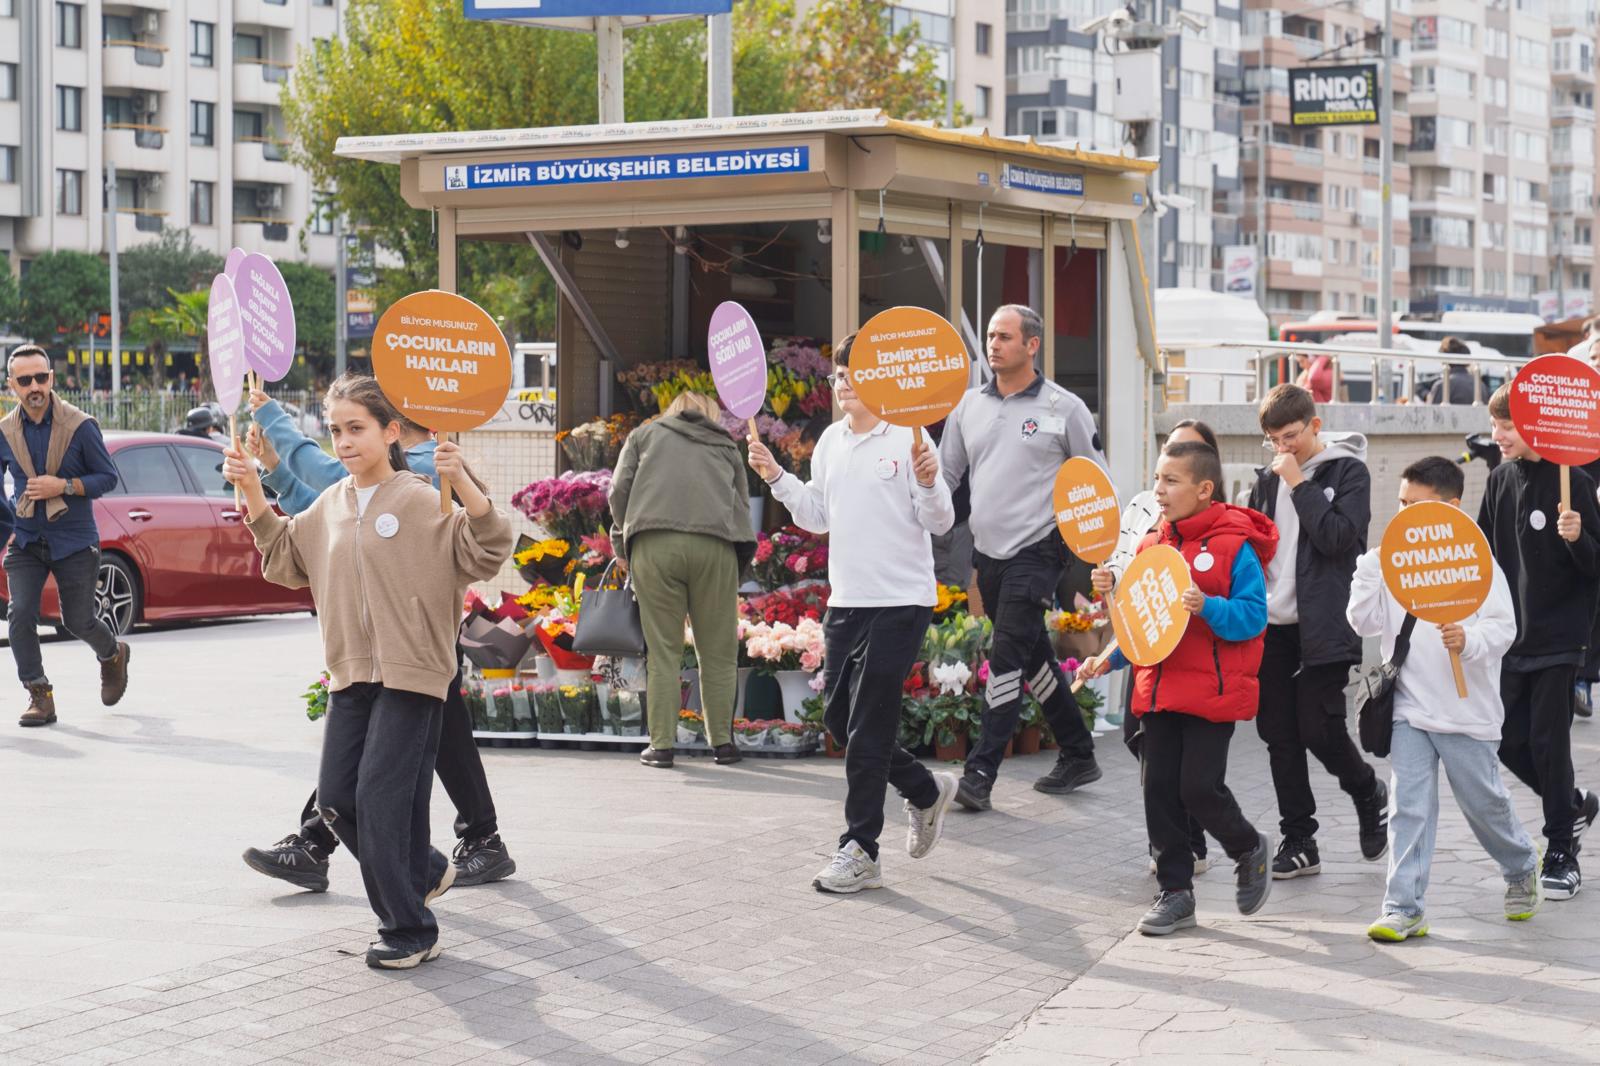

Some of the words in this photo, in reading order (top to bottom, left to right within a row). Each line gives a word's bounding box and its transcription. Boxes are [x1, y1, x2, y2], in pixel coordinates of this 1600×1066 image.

[1294, 72, 1367, 101] RİNDO
[1325, 99, 1374, 112] MOBİLYA
[474, 163, 531, 184] İZMİR
[536, 157, 670, 181] BÜYÜKŞEHİR
[676, 148, 800, 173] BELEDİYESİ
[401, 315, 431, 326] BİLİYOR
[432, 320, 478, 331] MUSUNUZ?
[710, 318, 748, 349] ÇOCUKLARIN
[870, 332, 897, 343] BİLİYOR
[897, 327, 937, 338] MUSUNUZ?
[385, 333, 496, 356] ÇOCUKLARIN
[715, 340, 736, 365] SÖZÜ
[734, 335, 752, 354] VAR
[405, 355, 478, 374] HAKLARI
[854, 364, 906, 385] ÇOCUK
[908, 353, 965, 375] MECLİSİ
[425, 376, 459, 392] VAR
[896, 376, 926, 390] VAR
[1518, 380, 1556, 396] ŞİDDET,
[1558, 385, 1590, 399] İHMAL
[1531, 373, 1590, 388] ÇOCUKLARI
[1528, 393, 1597, 410] İSTİSMARDAN
[1540, 406, 1589, 419] KORUYUN
[1067, 483, 1096, 503] EĞİTİM
[1058, 508, 1074, 524] HER
[1073, 496, 1116, 521] ÇOCUĞUN
[1078, 516, 1104, 534] HAKKI
[1405, 523, 1454, 543] OYUN
[1391, 543, 1478, 568] OYNAMAK
[1158, 566, 1179, 608] HER
[1399, 565, 1482, 589] HAKKIMIZ
[1141, 567, 1174, 635] ÇOCUK
[1128, 579, 1160, 648] EŞİTTİR
